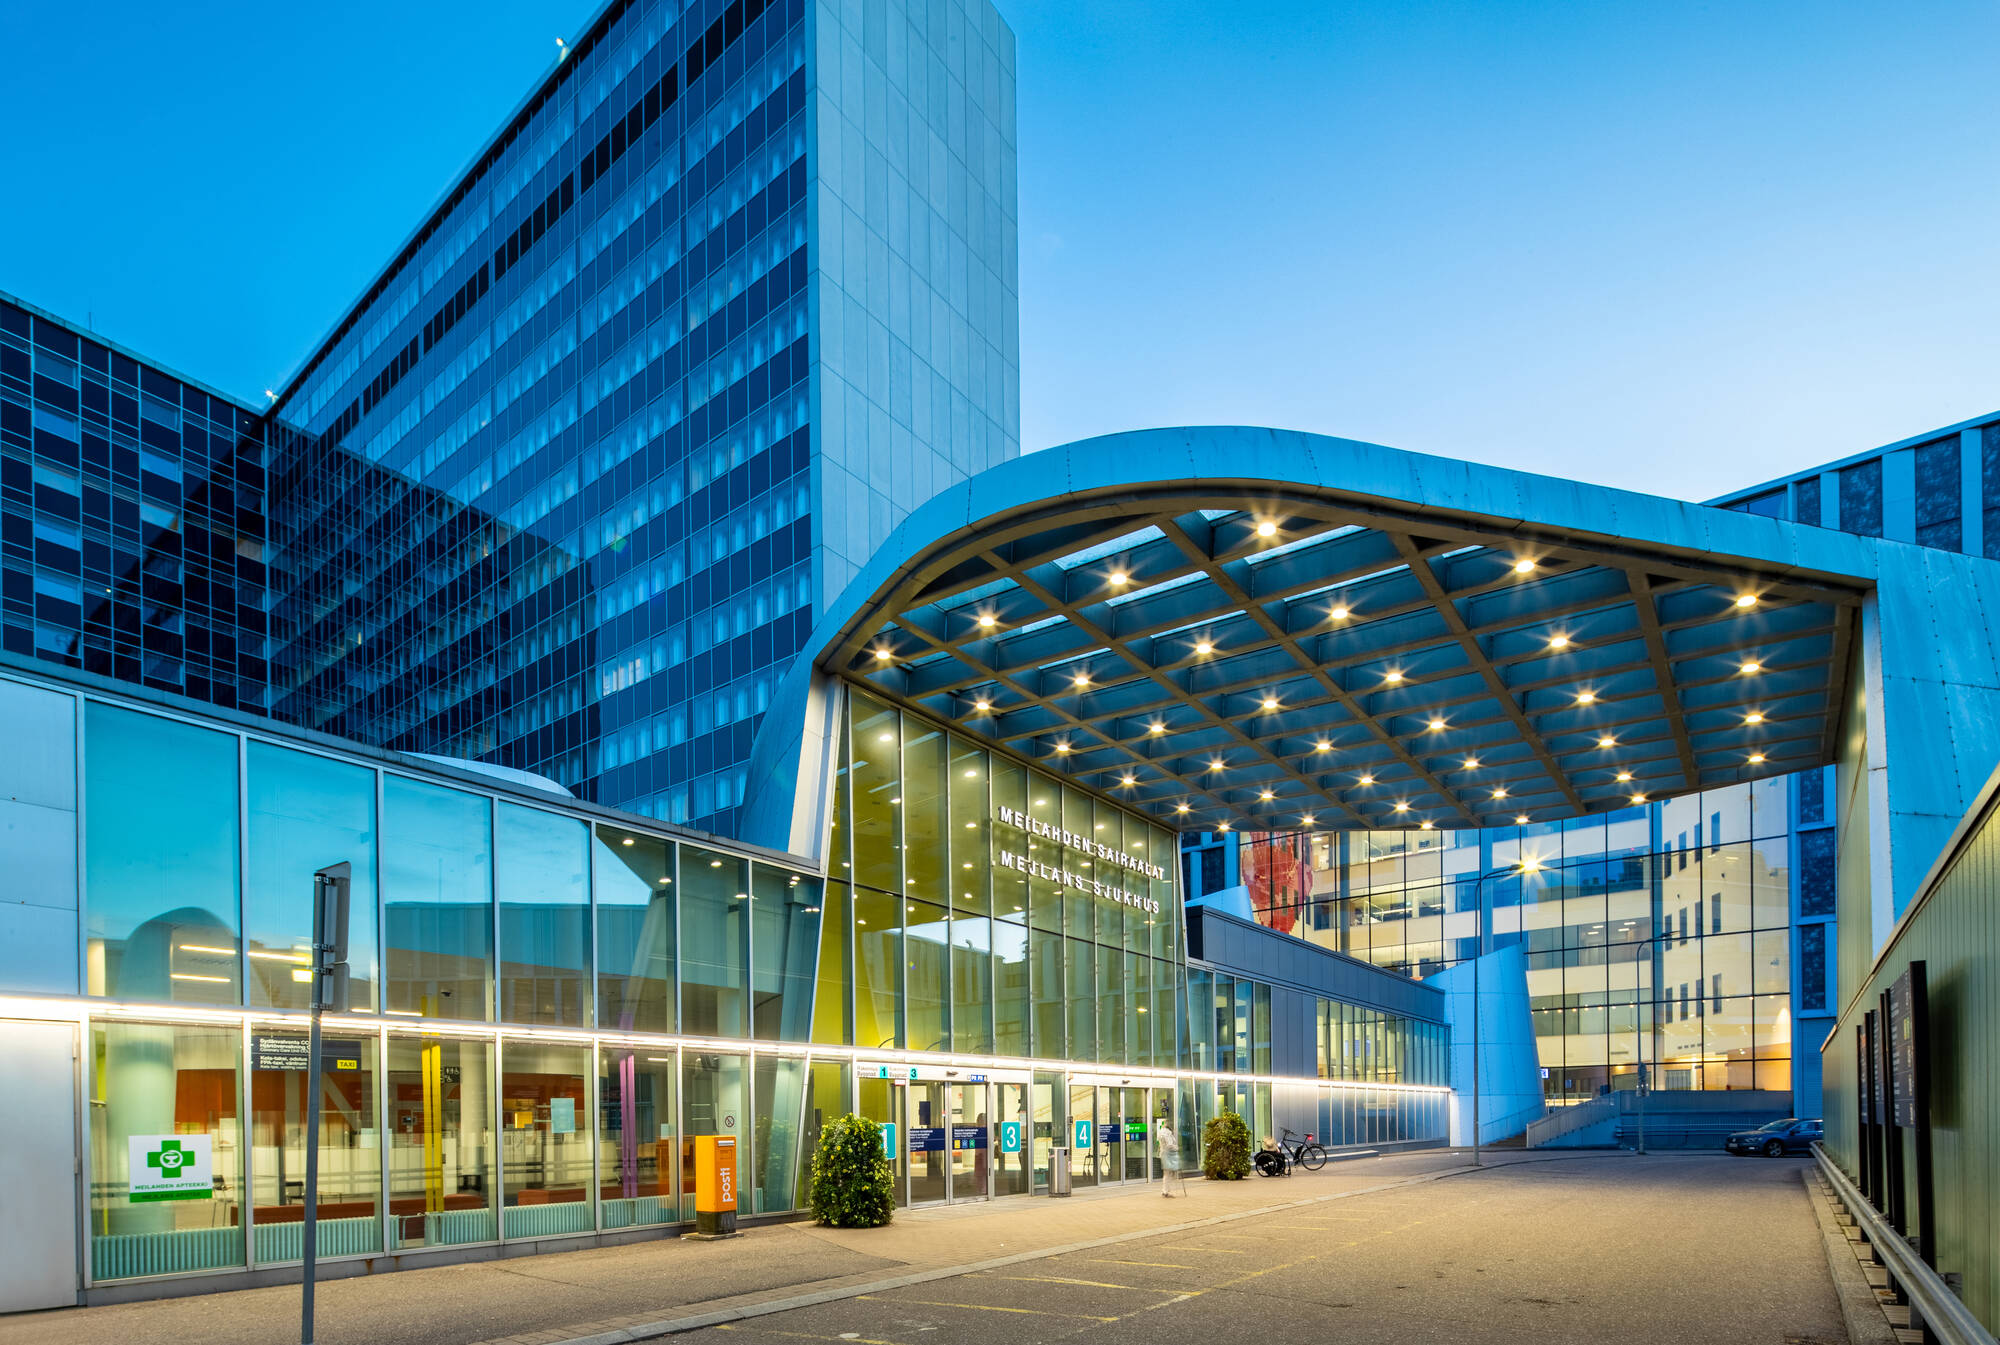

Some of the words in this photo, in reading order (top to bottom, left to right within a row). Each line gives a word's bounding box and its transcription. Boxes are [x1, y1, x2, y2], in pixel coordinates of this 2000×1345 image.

[999, 805, 1090, 853] MEILAHDEN
[1097, 843, 1165, 880] SAIRAALAT
[1000, 850, 1083, 890] MEJLANS
[1093, 881, 1160, 914] SJUKHUS
[910, 1068, 917, 1078] 3
[1006, 1126, 1016, 1148] 3
[1079, 1124, 1088, 1145] 4
[720, 1167, 734, 1202] posti
